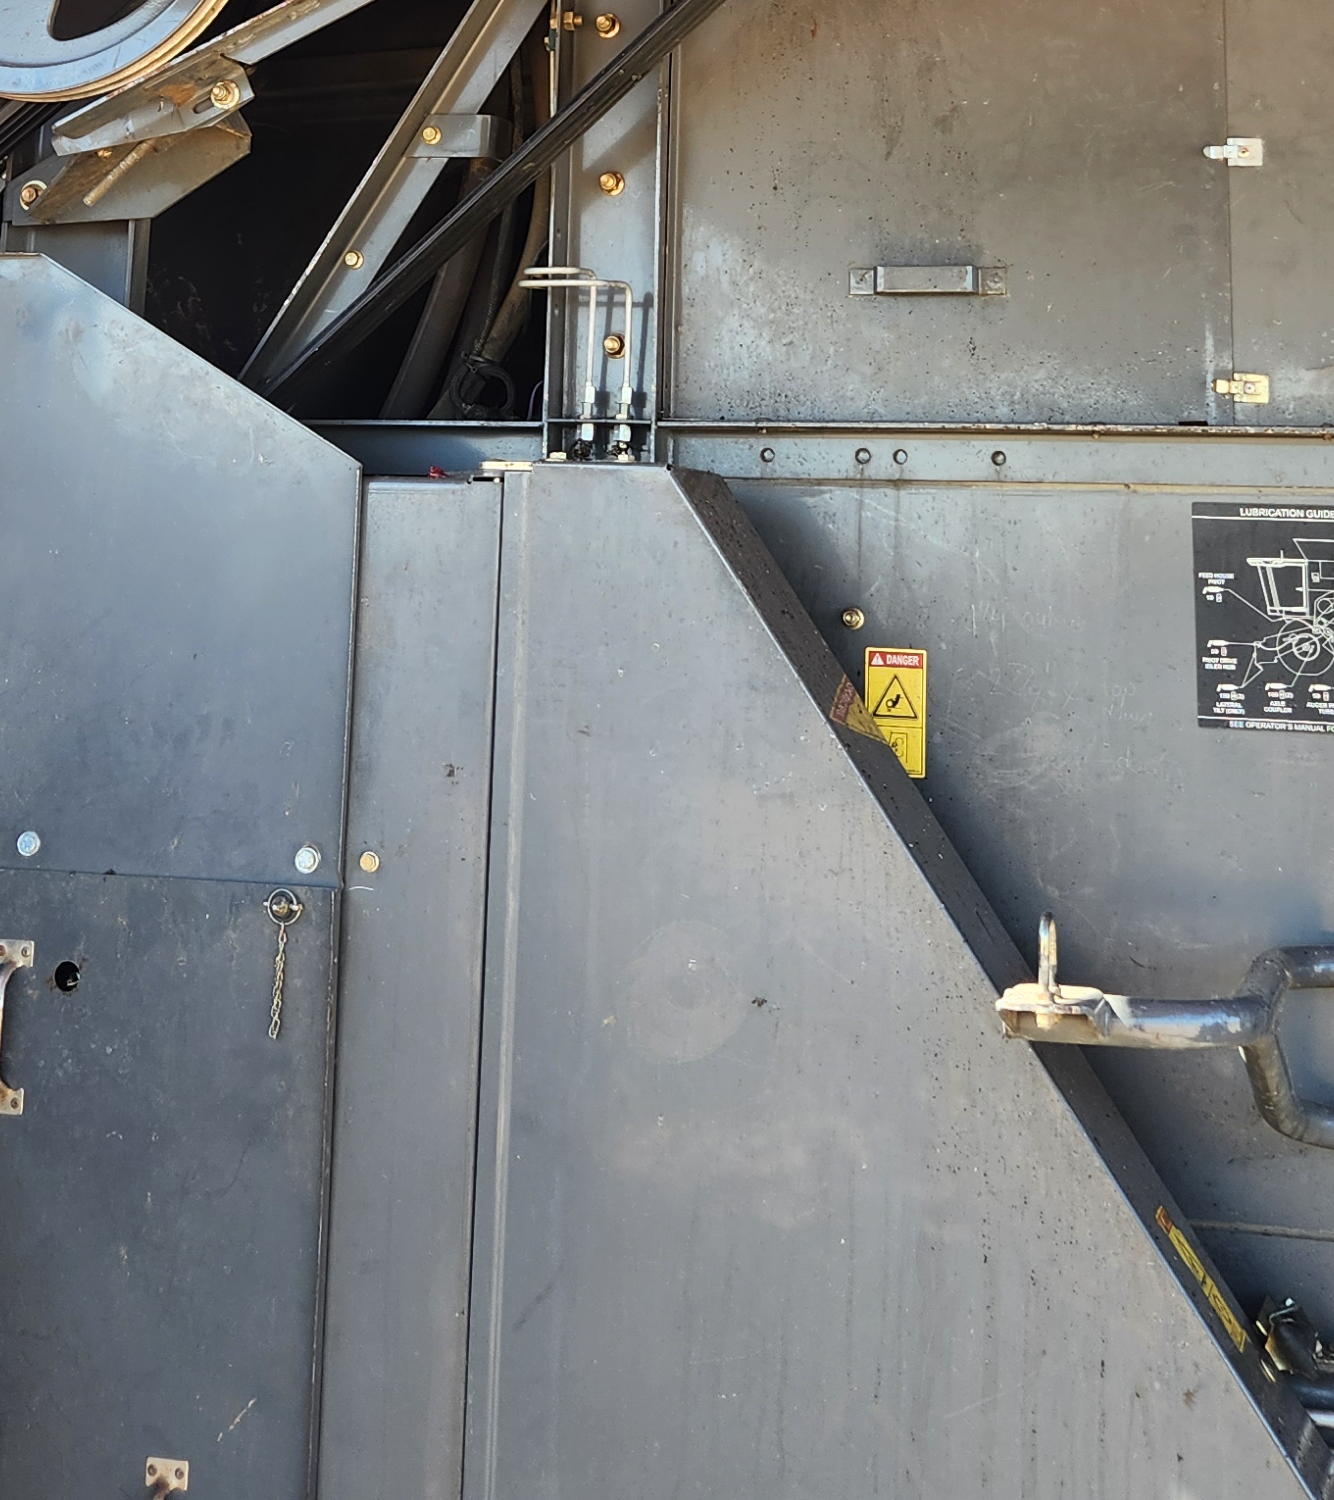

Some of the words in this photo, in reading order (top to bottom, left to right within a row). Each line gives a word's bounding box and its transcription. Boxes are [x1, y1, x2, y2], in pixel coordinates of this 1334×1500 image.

[1239, 508, 1305, 518] LUBRICATION
[887, 654, 919, 666] DANGER
[1229, 720, 1244, 728] SEE
[1245, 722, 1293, 730] OPERATOR'S
[1294, 723, 1325, 732] MANUAL
